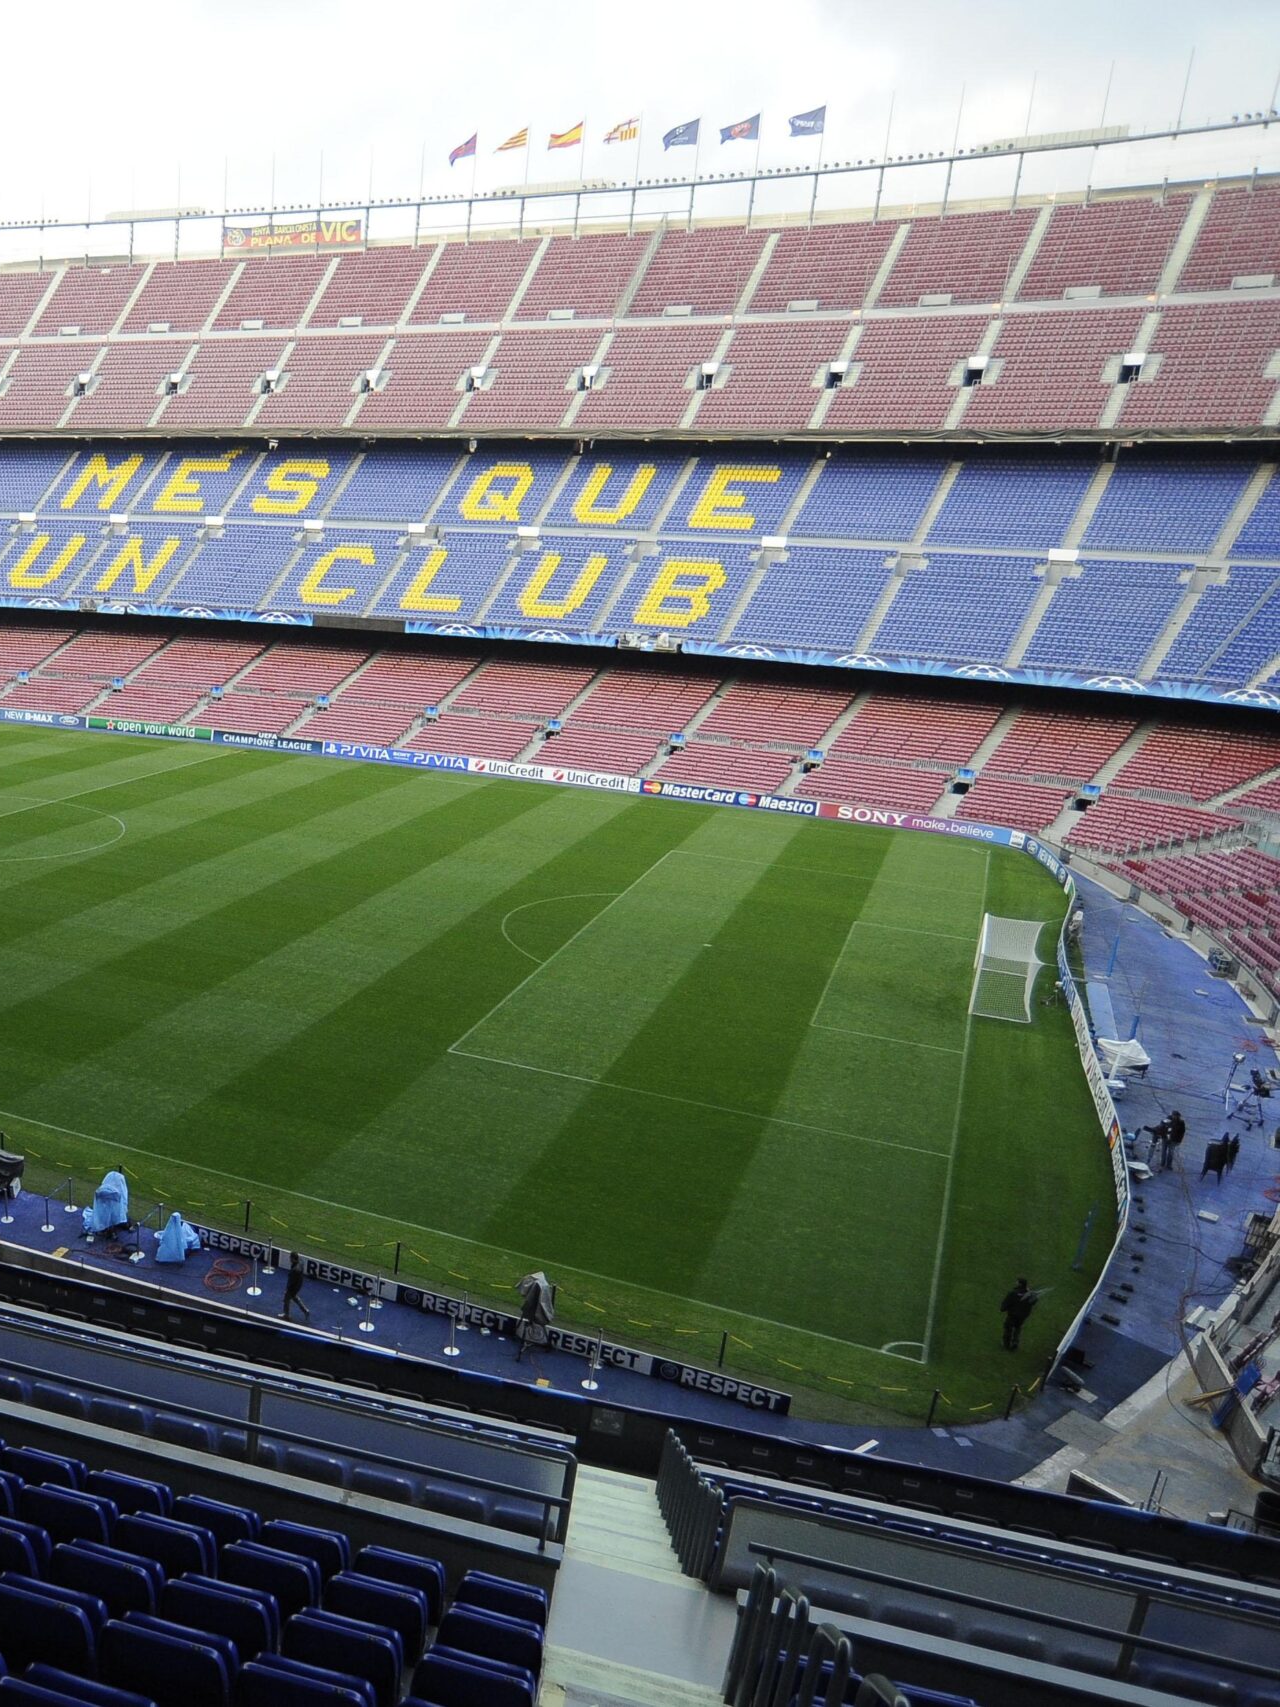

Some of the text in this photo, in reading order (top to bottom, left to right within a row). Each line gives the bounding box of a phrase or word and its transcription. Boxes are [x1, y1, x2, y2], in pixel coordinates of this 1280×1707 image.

[250, 232, 317, 247] PLANA DE
[321, 221, 356, 243] VIC
[60, 446, 781, 531] MÉS QUE
[6, 532, 728, 628] UN CLUB
[4, 711, 53, 723] NEW B-MAX
[117, 721, 196, 738] open your world
[223, 734, 312, 751] CHAMPIONS LEAGUE
[488, 763, 544, 778] UniCredit
[567, 773, 625, 789] UniCredit
[661, 784, 736, 804] MasterCard
[758, 796, 814, 815] Maestro
[837, 806, 995, 839] SONY make.believe
[198, 1228, 271, 1262] RESPECT
[307, 1259, 385, 1293] RESPECT
[422, 1294, 509, 1331] RESPECT
[549, 1330, 640, 1369] RESPECT
[680, 1367, 781, 1411] RESPECT
